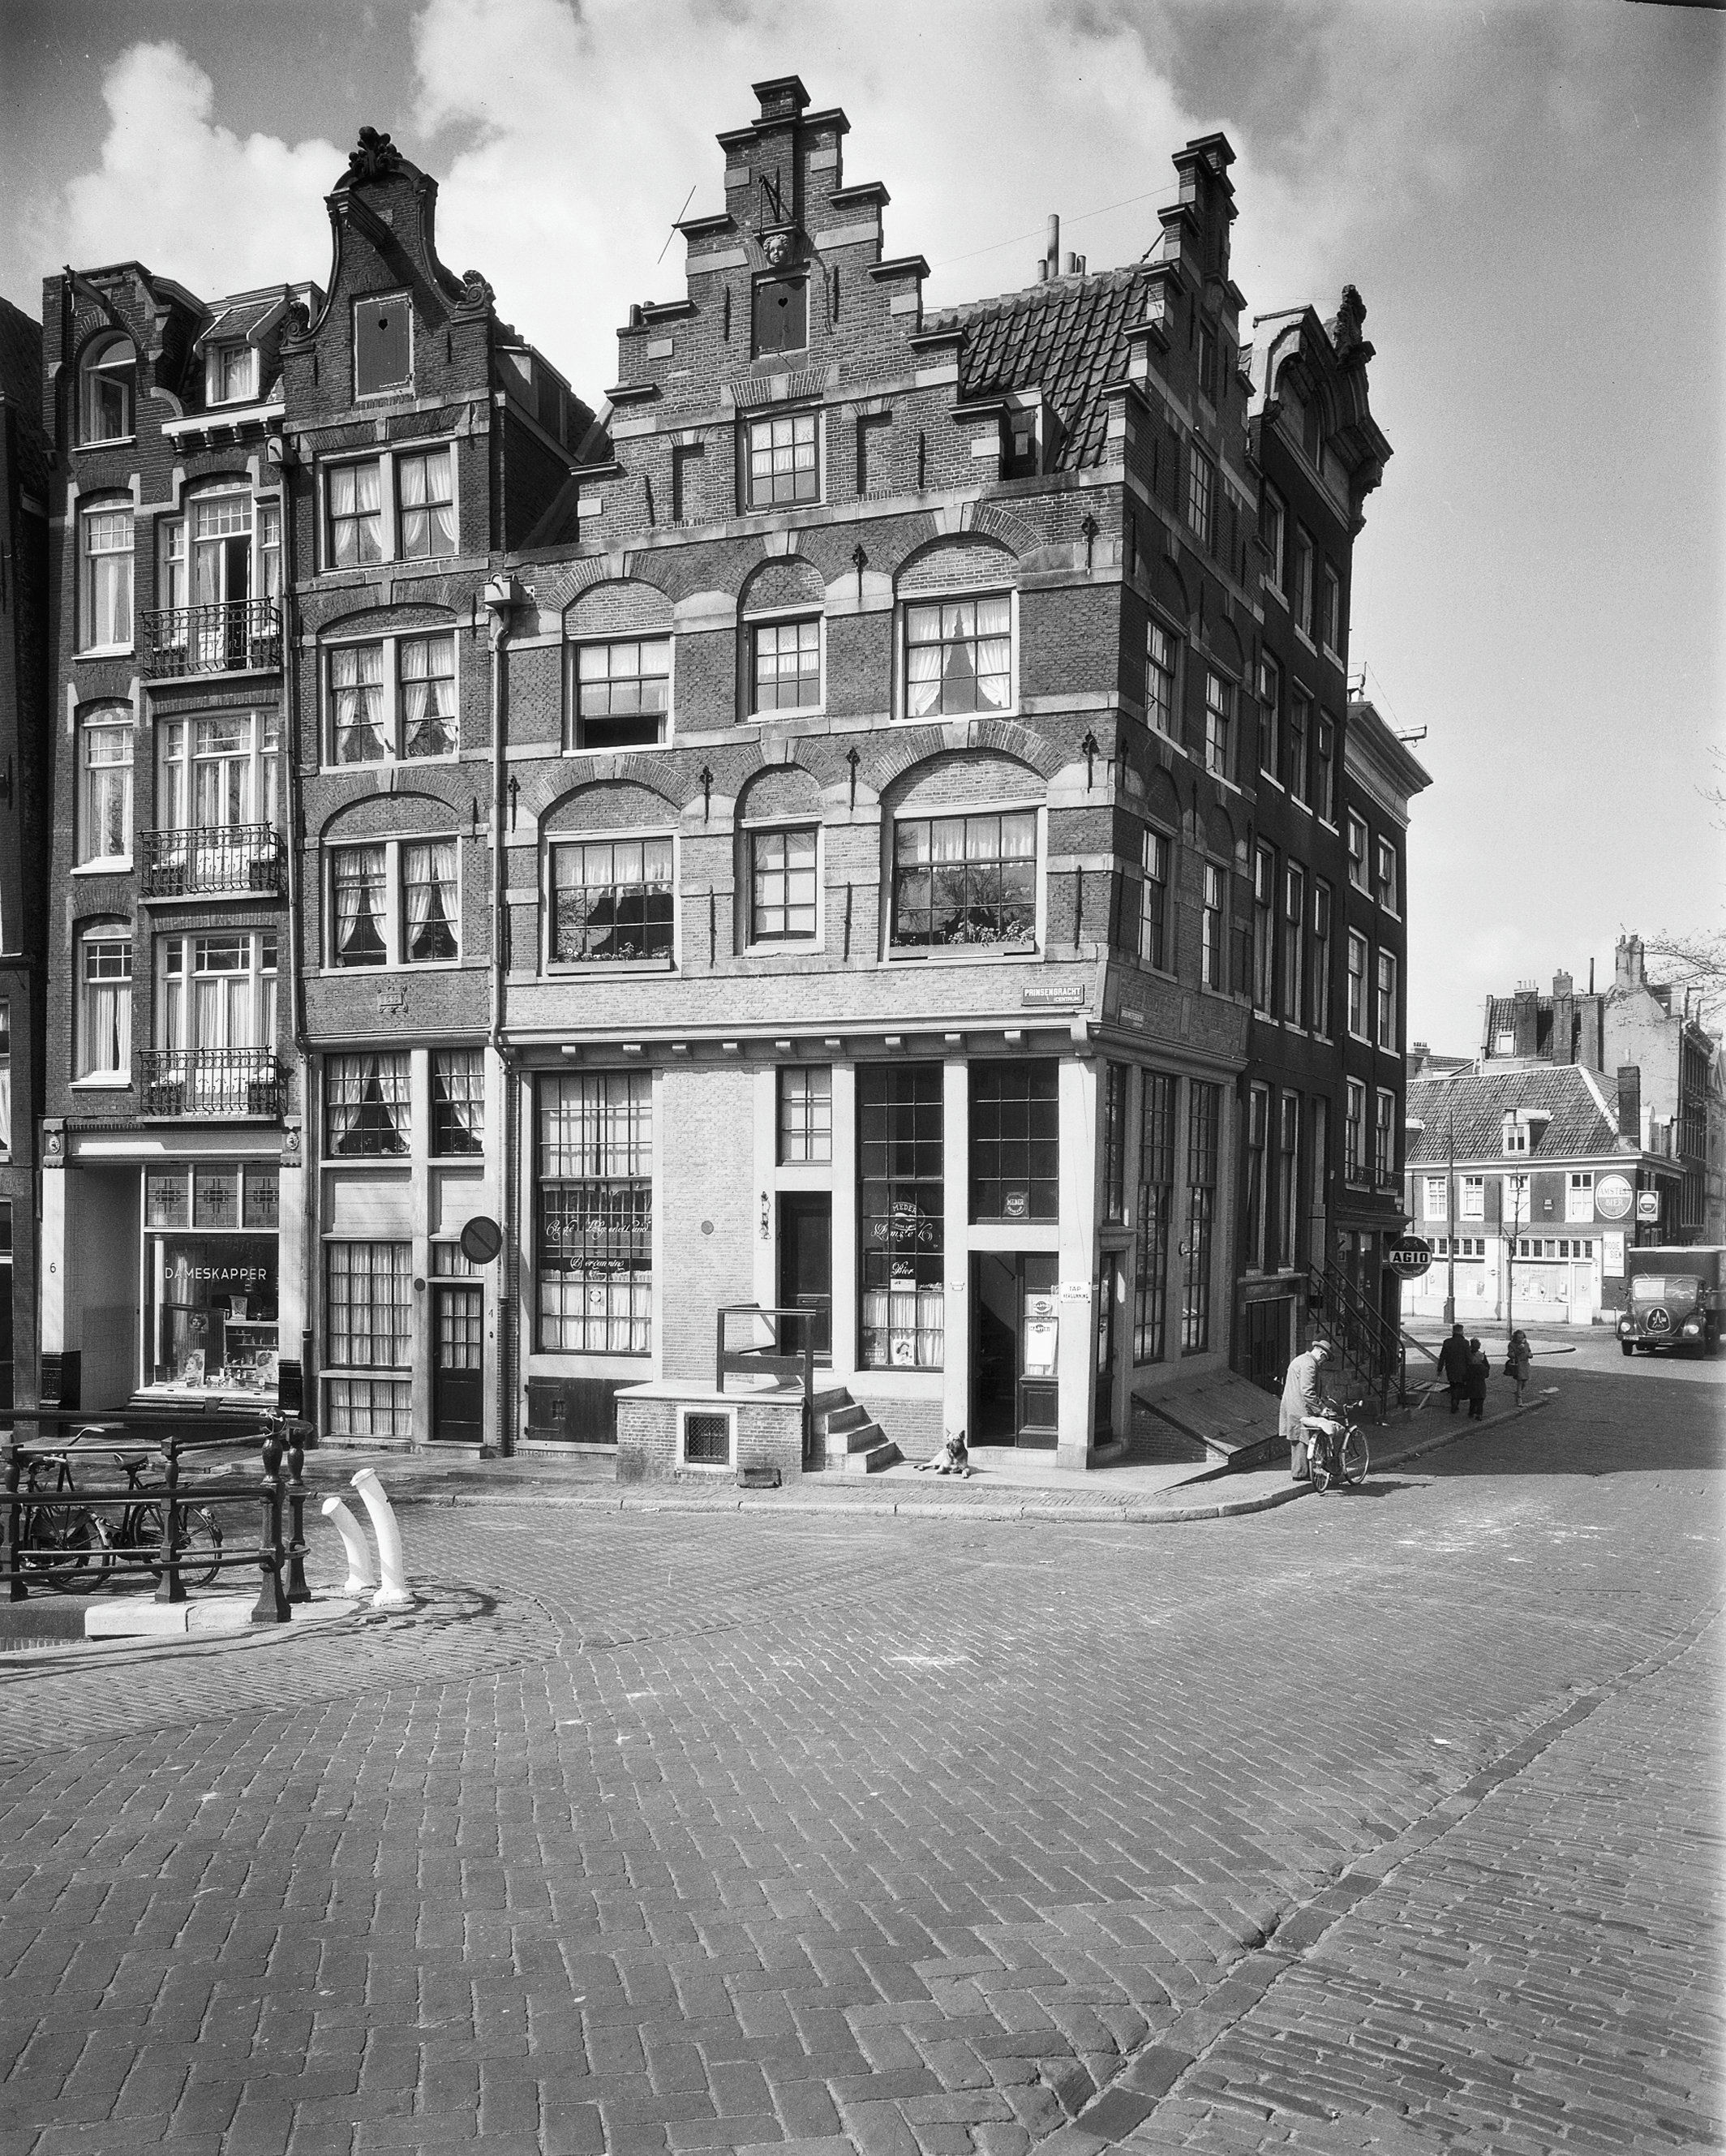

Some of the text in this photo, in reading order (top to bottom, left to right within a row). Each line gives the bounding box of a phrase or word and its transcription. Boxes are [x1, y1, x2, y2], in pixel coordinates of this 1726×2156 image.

[1024, 987, 1081, 997] PRINSENGRACHT
[1600, 1187, 1629, 1195] AMSTEL
[1605, 1198, 1624, 1207] BIER
[1393, 1252, 1428, 1263] AGIO
[49, 1262, 57, 1273] 6
[890, 1261, 914, 1278] Bier
[165, 1267, 267, 1280] DAMESKAPPER
